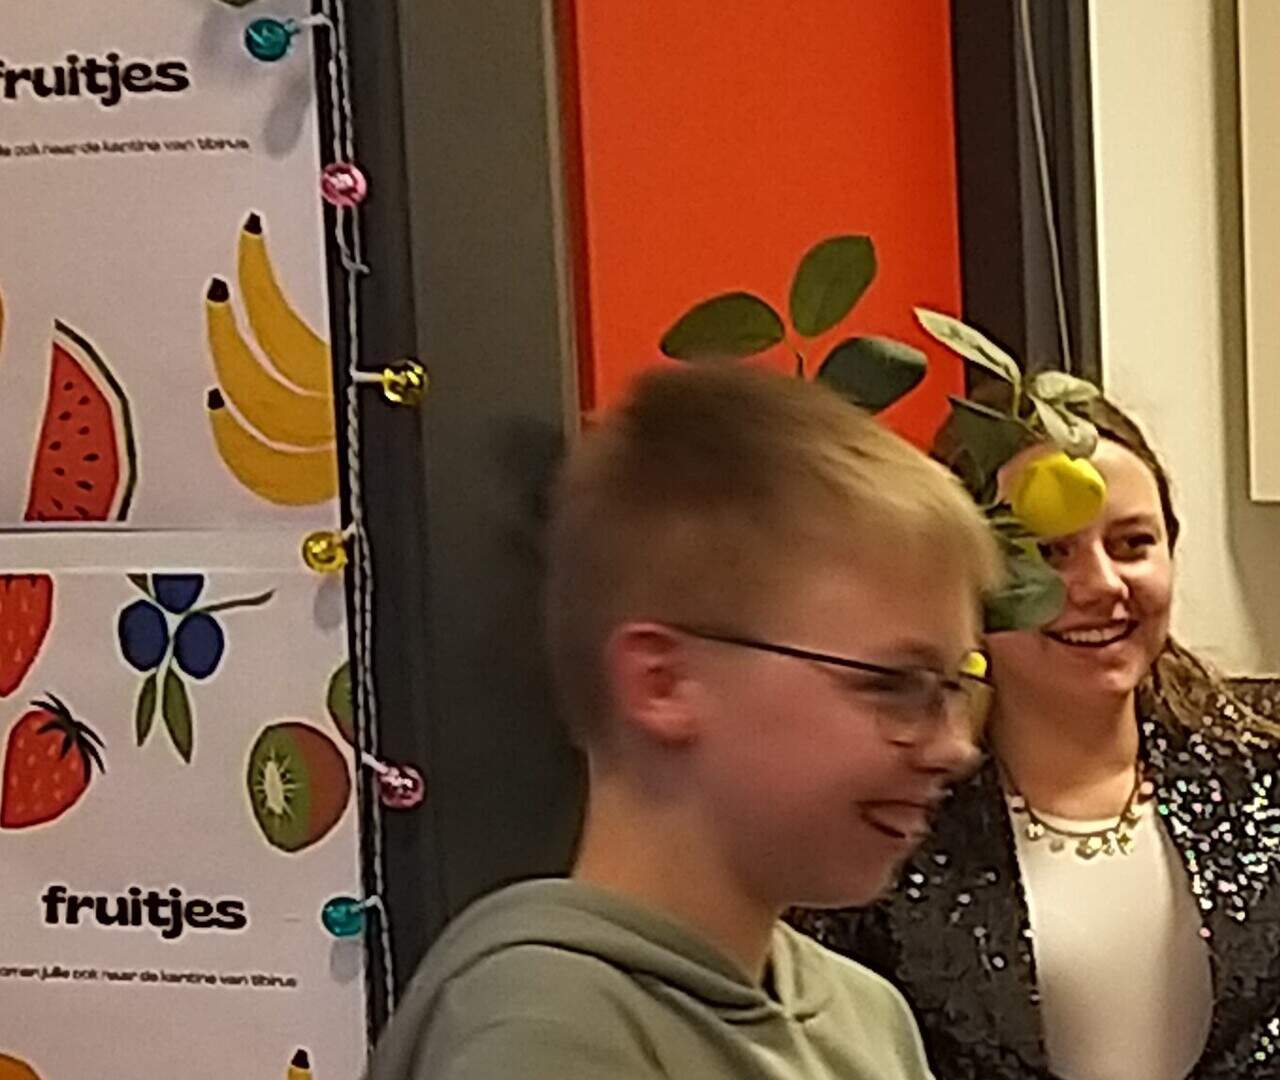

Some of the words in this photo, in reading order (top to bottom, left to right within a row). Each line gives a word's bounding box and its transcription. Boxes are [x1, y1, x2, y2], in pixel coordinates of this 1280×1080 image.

[0, 52, 190, 107] ruitjes
[42, 885, 248, 939] fruitjes
[0, 966, 39, 978] omen
